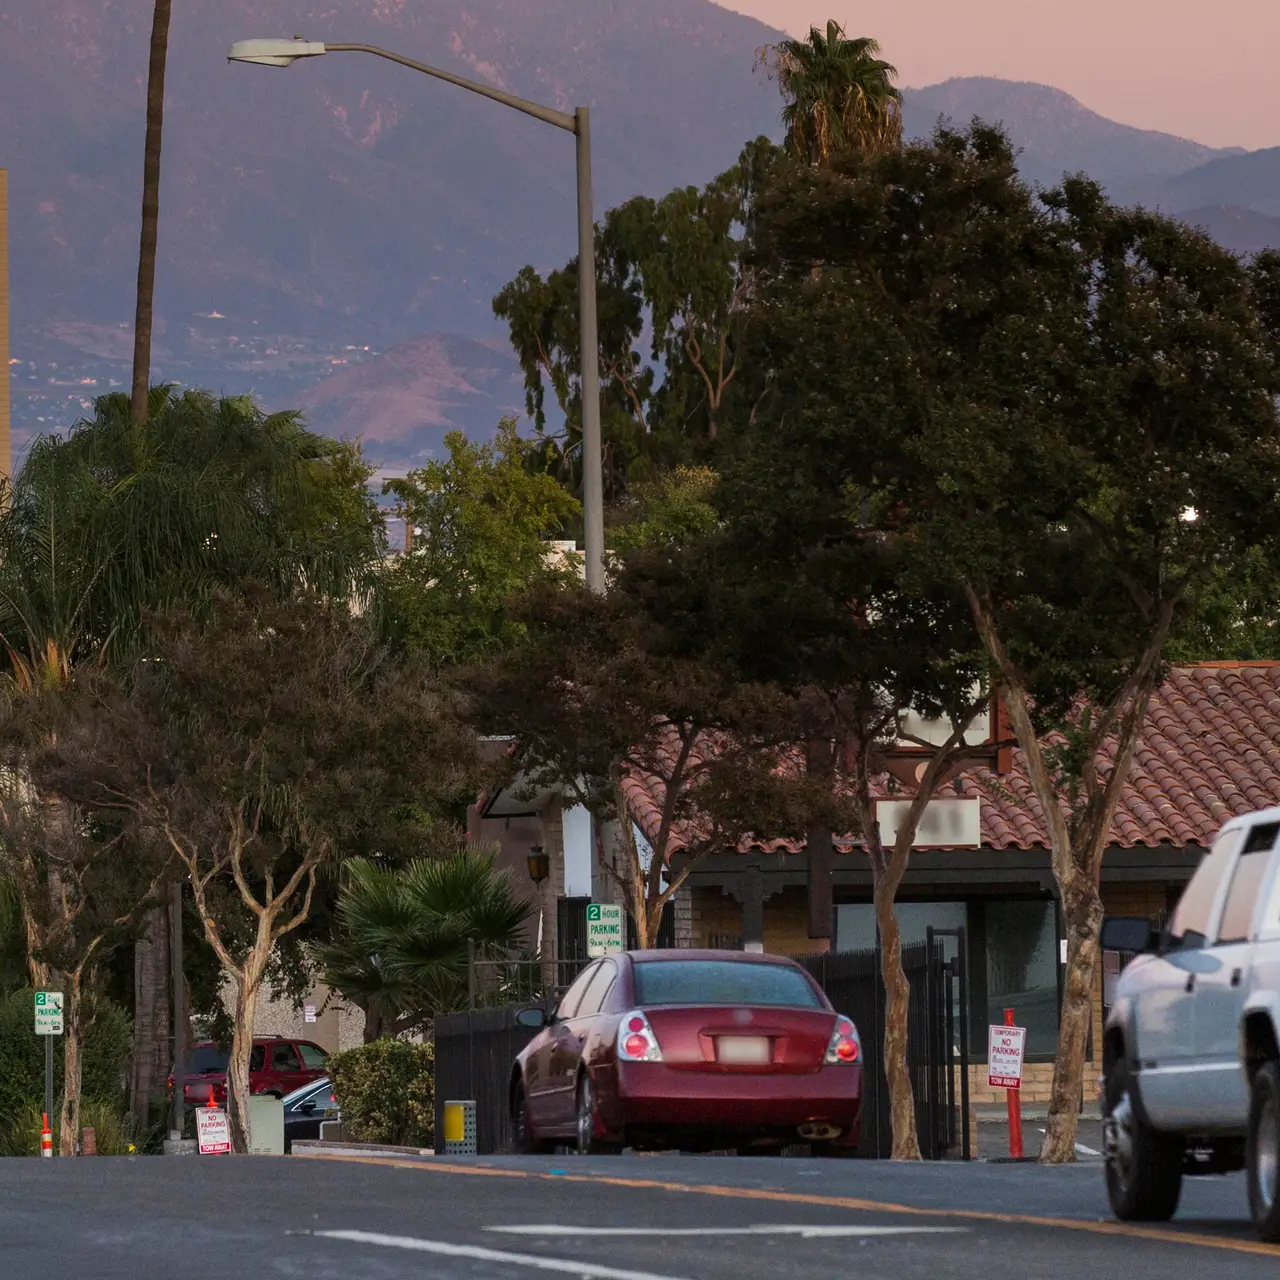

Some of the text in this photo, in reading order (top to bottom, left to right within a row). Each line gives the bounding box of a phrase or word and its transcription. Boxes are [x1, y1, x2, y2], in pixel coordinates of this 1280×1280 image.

[590, 907, 620, 919] 2 HOUR
[590, 924, 620, 934] PARKING
[37, 995, 45, 1004] 2
[992, 1046, 1020, 1056] PARKING
[1002, 1078, 1018, 1086] AWAY
[201, 1121, 226, 1129] PARKING
[202, 1143, 228, 1152] TOW AWAY
